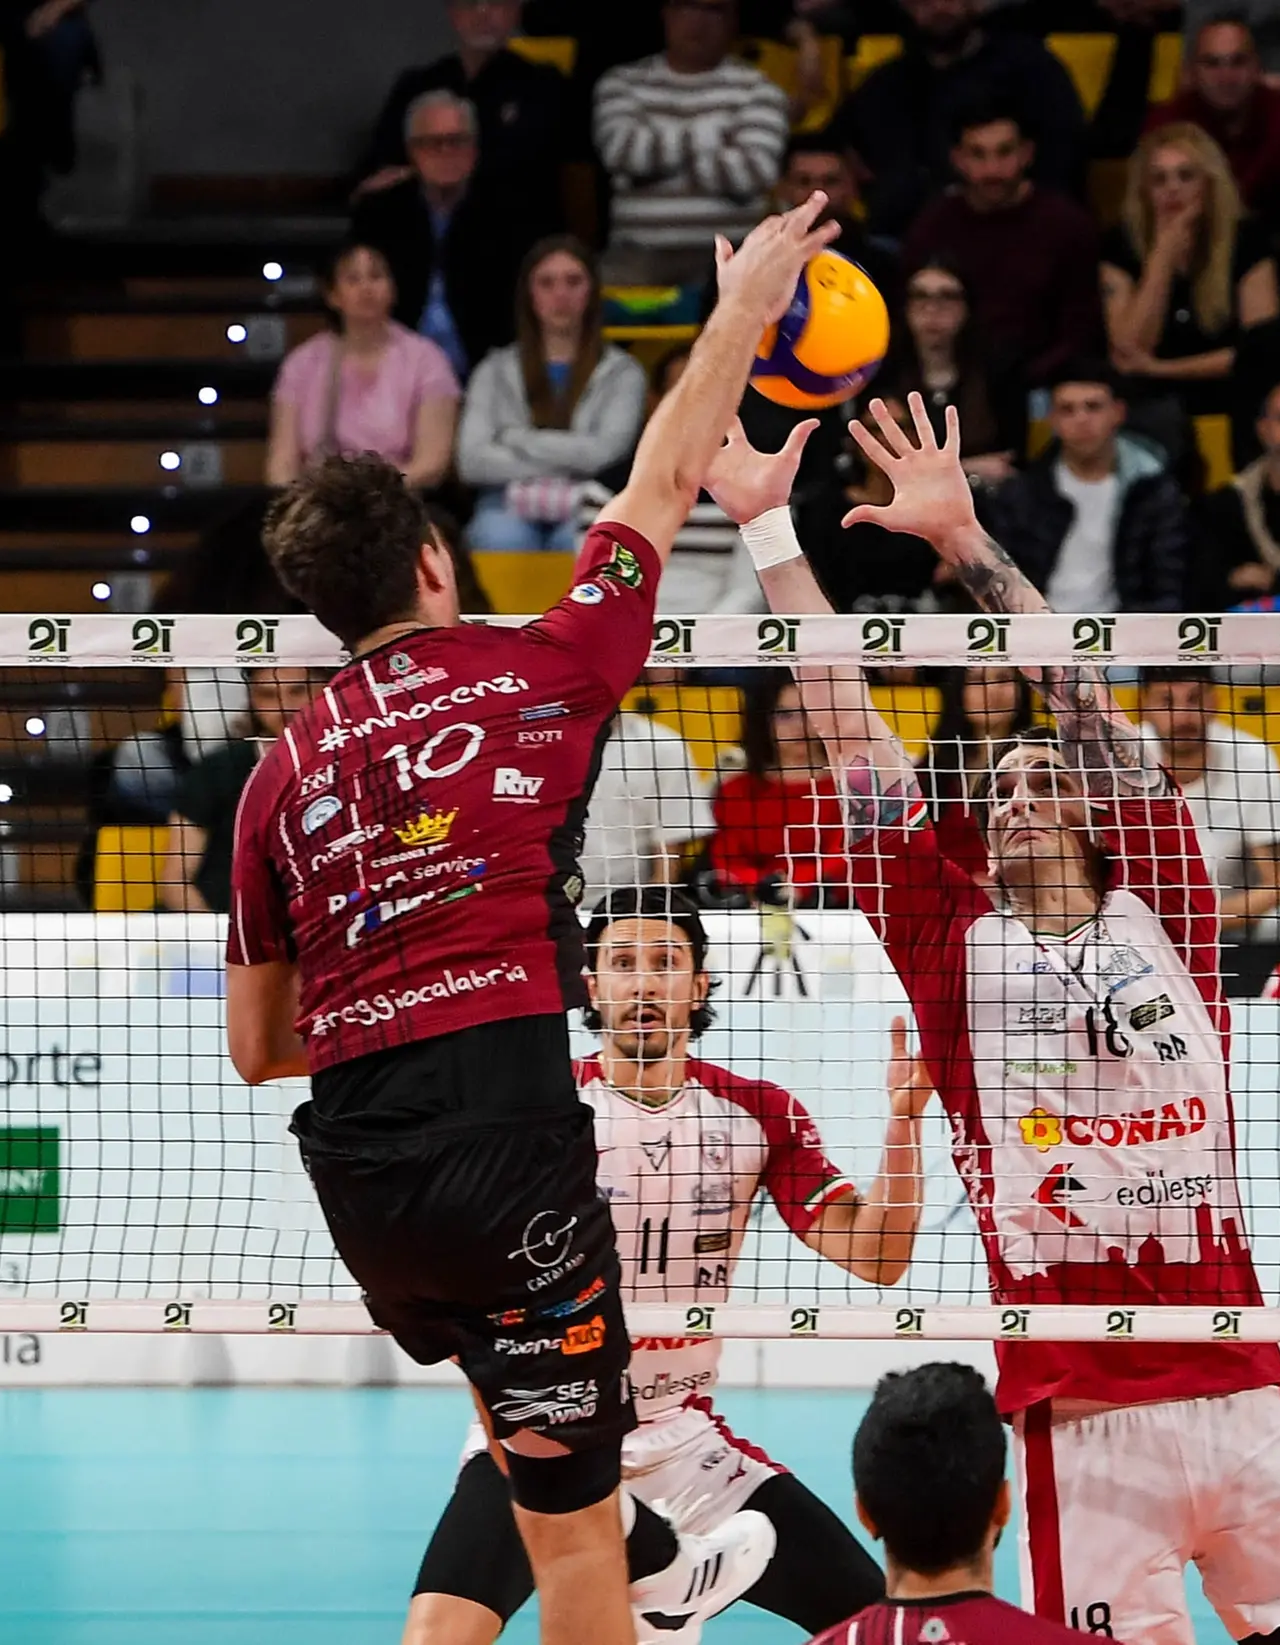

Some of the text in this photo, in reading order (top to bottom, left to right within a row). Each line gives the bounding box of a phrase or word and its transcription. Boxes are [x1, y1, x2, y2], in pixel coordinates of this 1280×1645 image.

[317, 672, 530, 753] #innocenzi
[382, 722, 486, 791] 10
[311, 963, 529, 1036] #reggiocalabria
[1065, 1096, 1207, 1147] CONAD
[640, 1217, 669, 1274] 11
